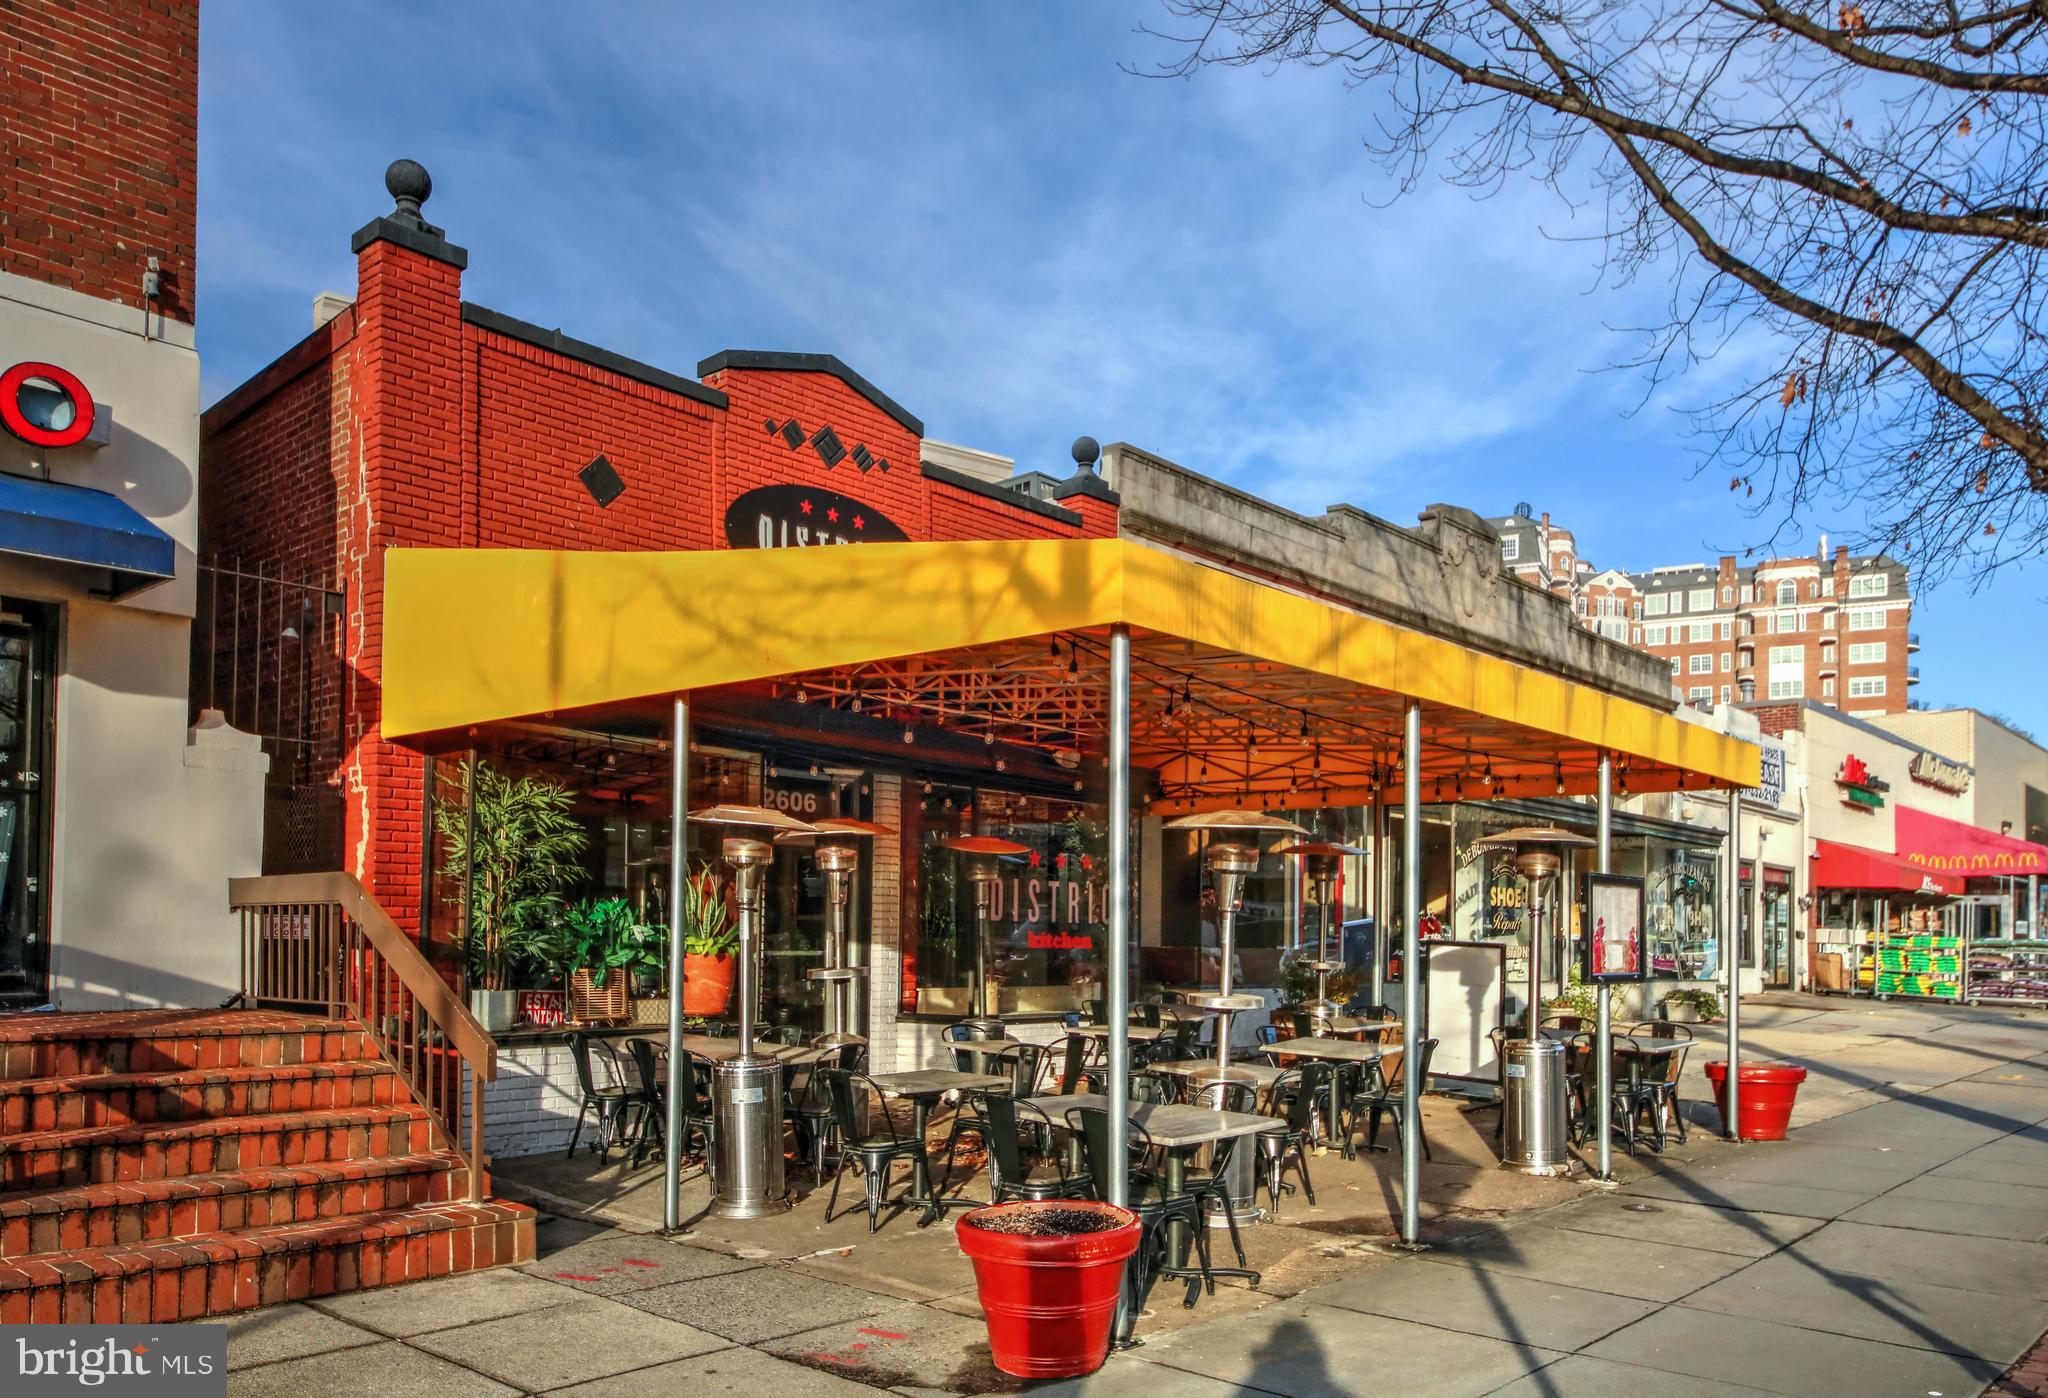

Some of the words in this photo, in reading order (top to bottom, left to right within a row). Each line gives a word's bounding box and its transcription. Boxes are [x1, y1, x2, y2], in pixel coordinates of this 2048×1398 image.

[764, 788, 816, 813] 2606
[991, 876, 1109, 924] DISTRIC
[1490, 886, 1521, 908] SHOE
[1492, 912, 1522, 934] Repair
[1027, 930, 1093, 949] kitchen
